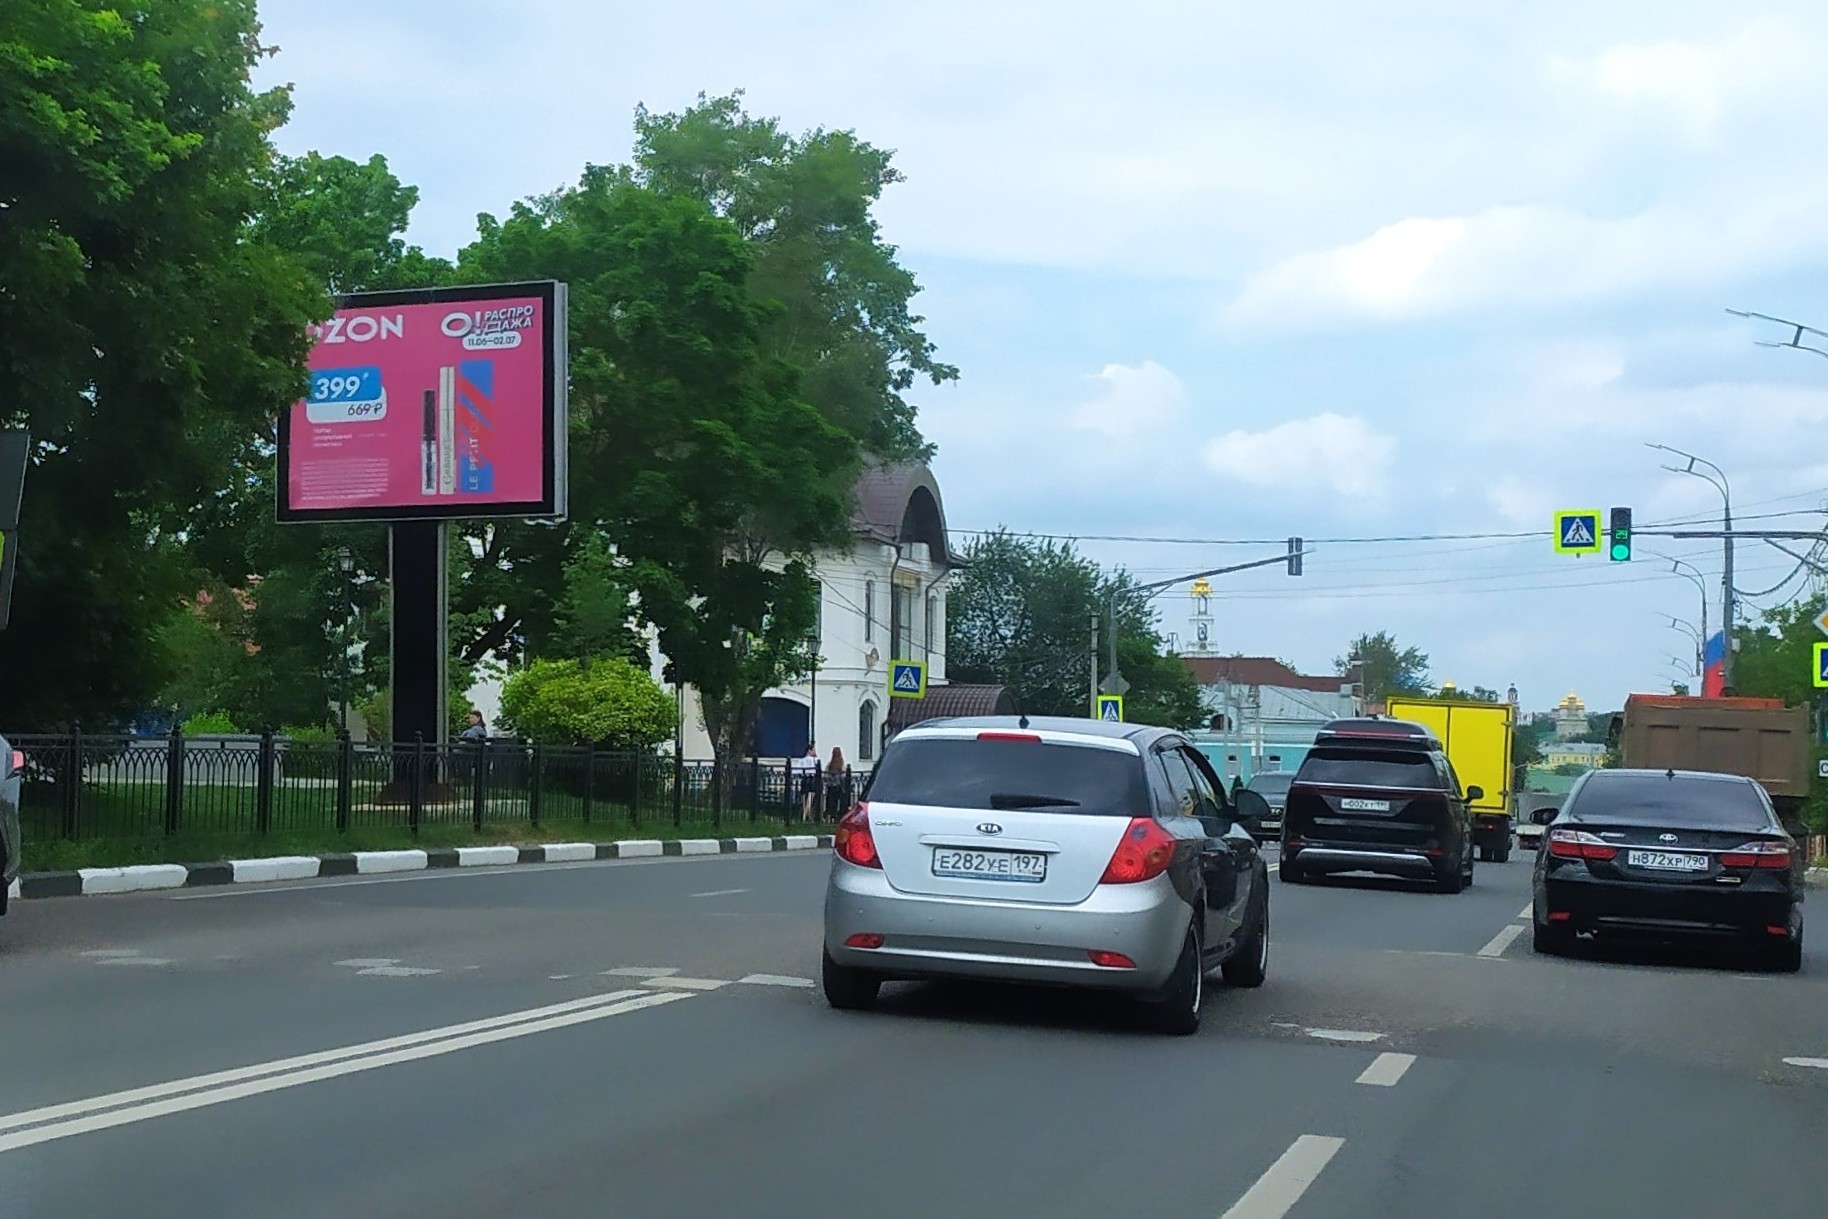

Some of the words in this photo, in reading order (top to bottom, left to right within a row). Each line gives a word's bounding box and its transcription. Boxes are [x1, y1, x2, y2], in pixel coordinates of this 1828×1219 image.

[485, 305, 533, 320] РАСПРО
[483, 317, 532, 334] ДАЖА
[980, 822, 1000, 833] KIA
[1013, 854, 1040, 870] 197
[1685, 855, 1706, 866] 790
